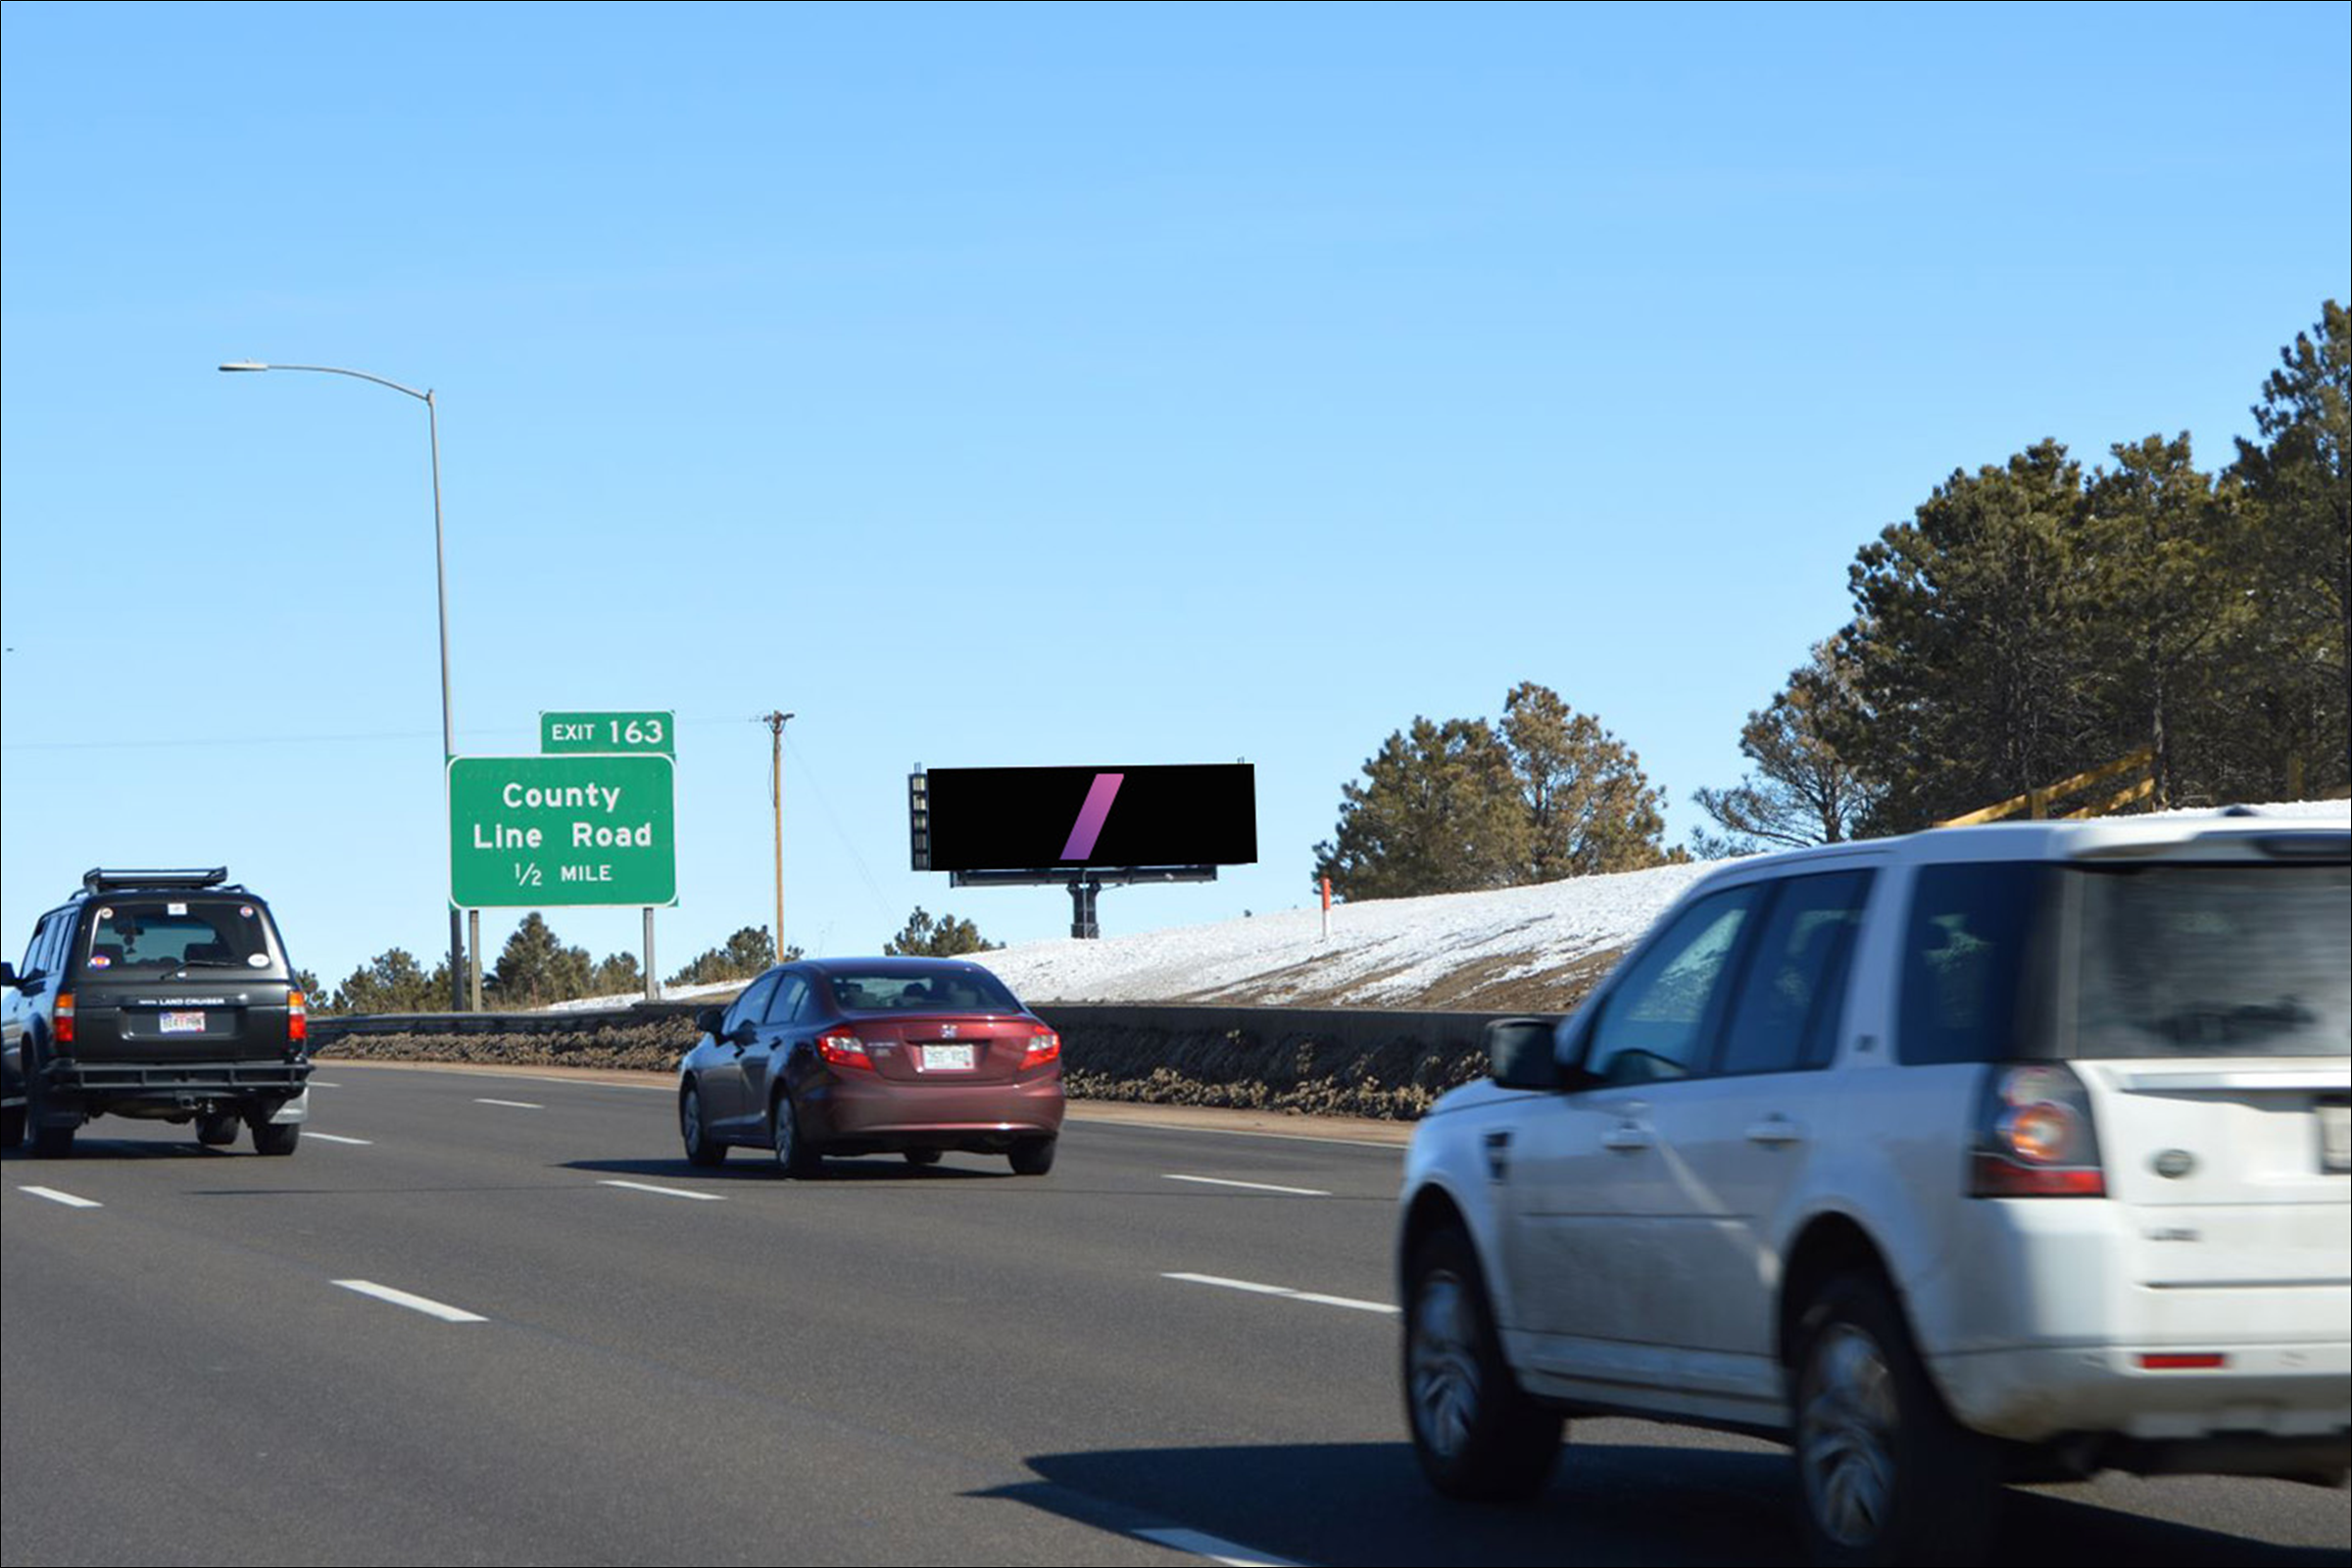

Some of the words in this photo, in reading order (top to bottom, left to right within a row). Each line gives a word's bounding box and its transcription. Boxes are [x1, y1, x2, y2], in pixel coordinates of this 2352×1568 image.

[552, 723, 596, 741] EXIT
[610, 719, 662, 744] 163
[503, 782, 621, 812] County
[473, 823, 543, 849] Line
[571, 821, 652, 848] Road
[561, 864, 612, 882] MILE
